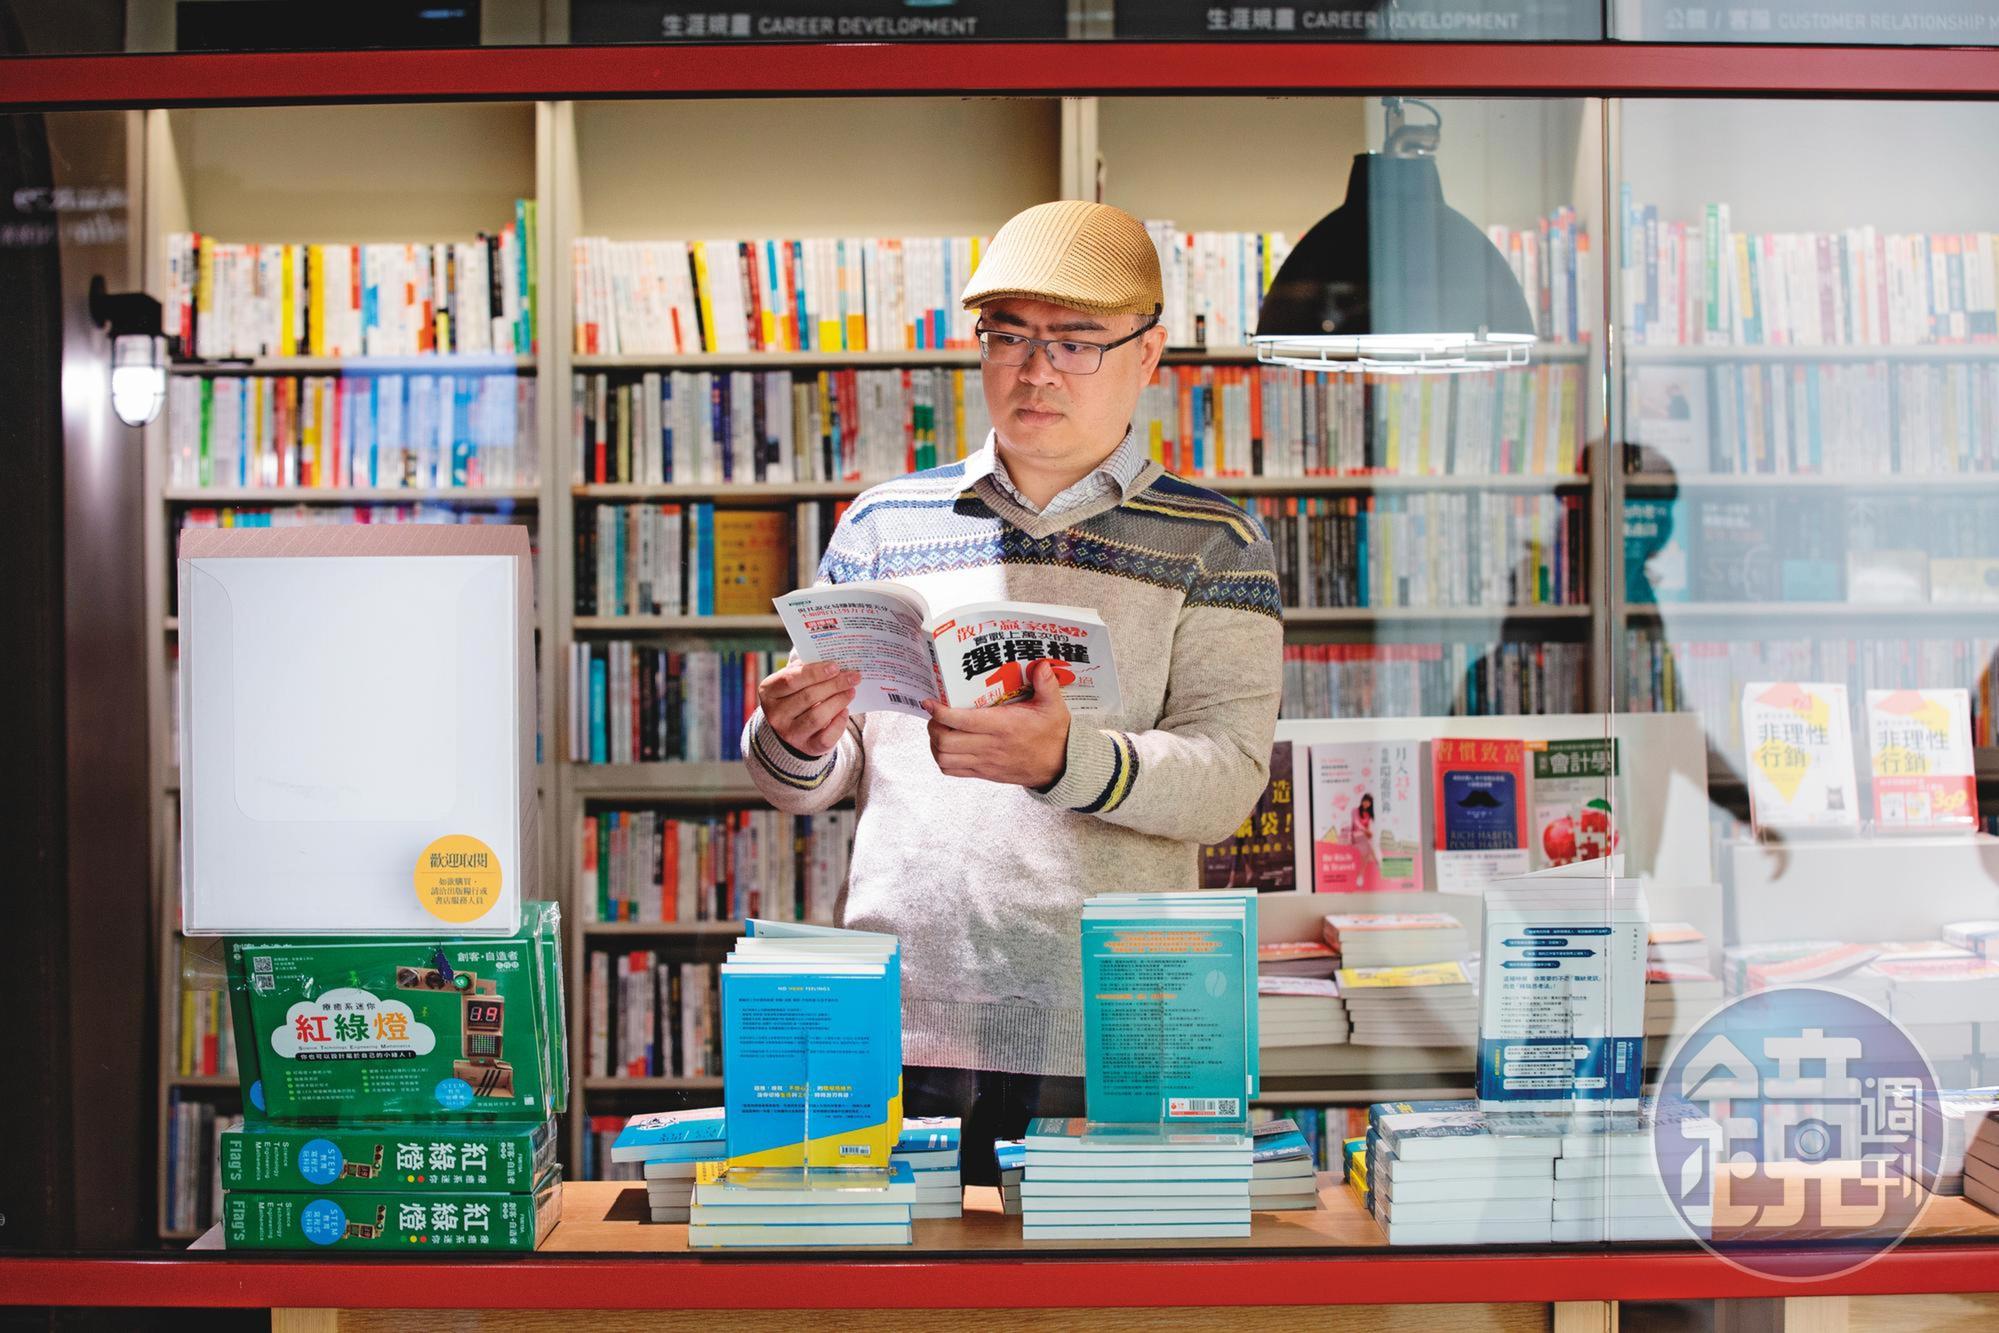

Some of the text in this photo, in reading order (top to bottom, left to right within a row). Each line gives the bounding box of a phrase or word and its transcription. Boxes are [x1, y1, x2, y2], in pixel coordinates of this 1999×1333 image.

[758, 16, 978, 35] CAREER DEVELOPMENT
[1302, 11, 1378, 29] CAREER
[1779, 13, 1866, 31] CUSTOMER
[961, 639, 1091, 681] 選擇權
[1757, 724, 1829, 746] 非理性
[1877, 731, 1950, 752] 非理性
[1438, 741, 1521, 764] 習慣致富
[1550, 751, 1611, 774] 會計學
[1760, 746, 1808, 769] 行銷
[1879, 753, 1927, 774] 行銷
[430, 853, 488, 868] 歡迎取閱
[295, 1012, 410, 1042] 紅綠燈
[228, 1140, 242, 1180] Flag's
[328, 1148, 336, 1175] STEM
[397, 1143, 488, 1171] 紅綠燈
[231, 1201, 245, 1241] Flag's
[330, 1209, 338, 1236] STEM
[400, 1203, 490, 1231] 紅綠燈
